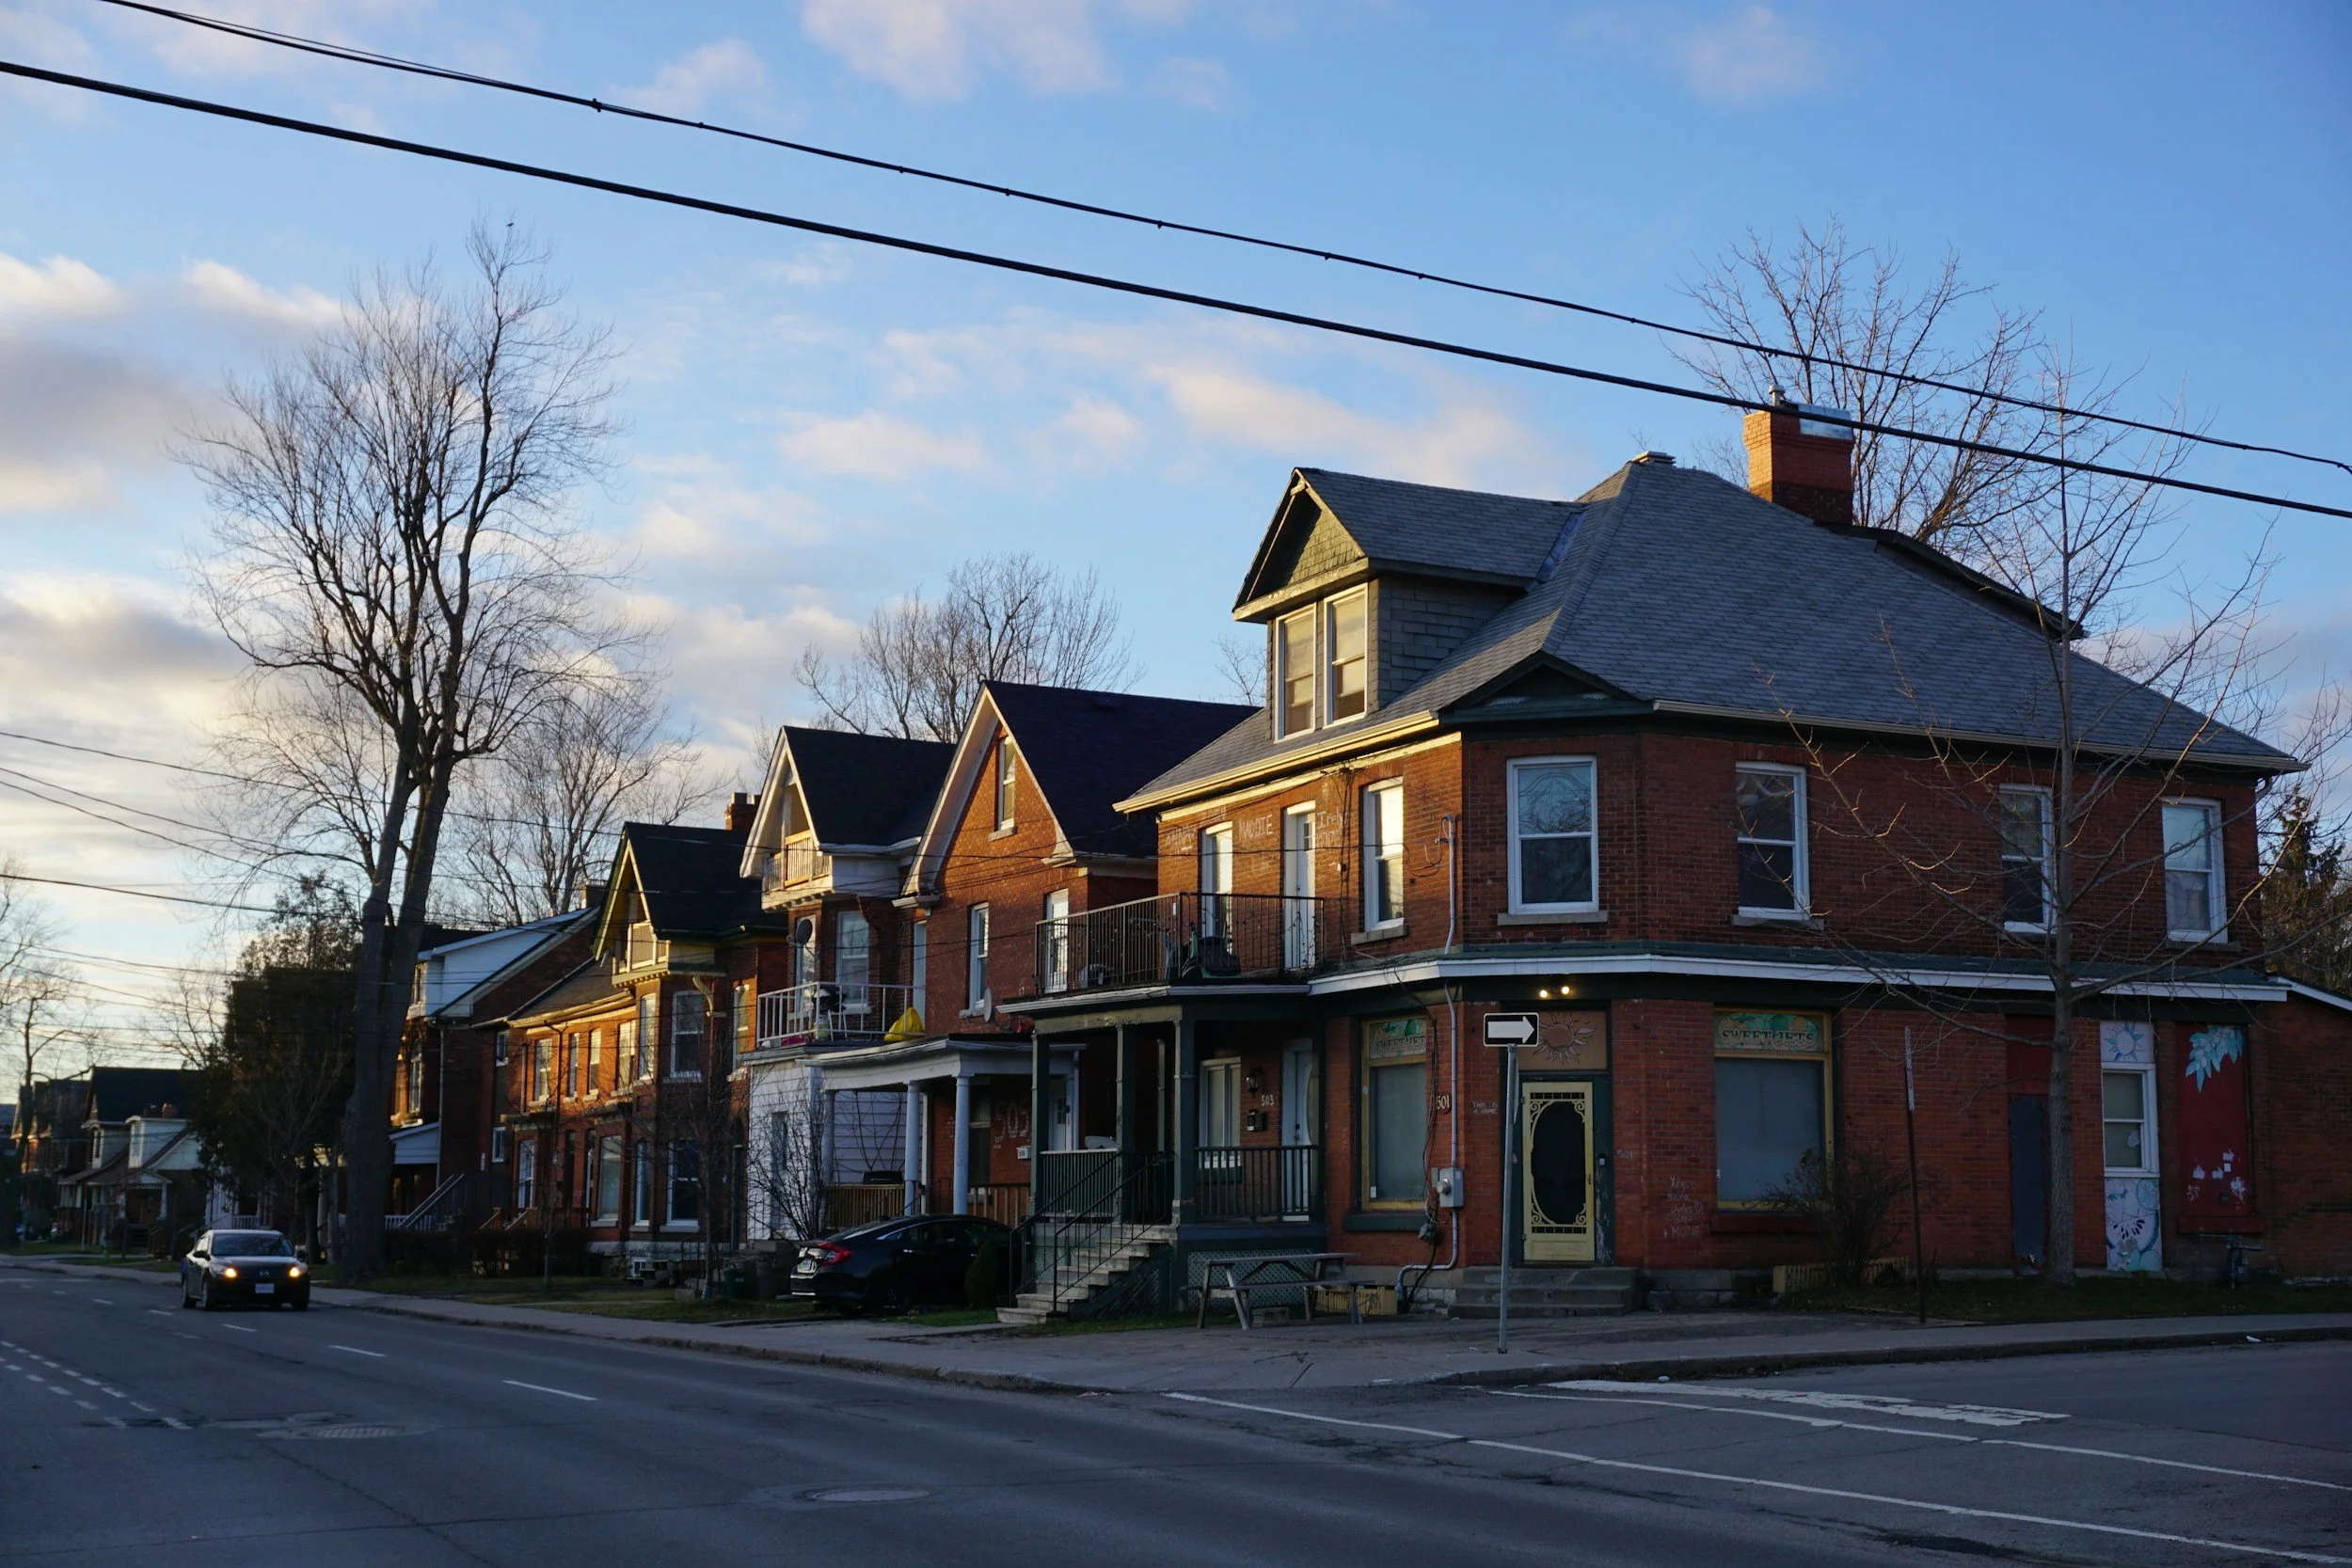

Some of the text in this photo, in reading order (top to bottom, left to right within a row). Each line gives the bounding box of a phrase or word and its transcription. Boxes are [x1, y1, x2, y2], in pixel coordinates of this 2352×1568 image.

[1722, 1029, 1814, 1044] SWEET JETS
[1261, 1094, 1274, 1106] 503
[1436, 1095, 1450, 1110] 501
